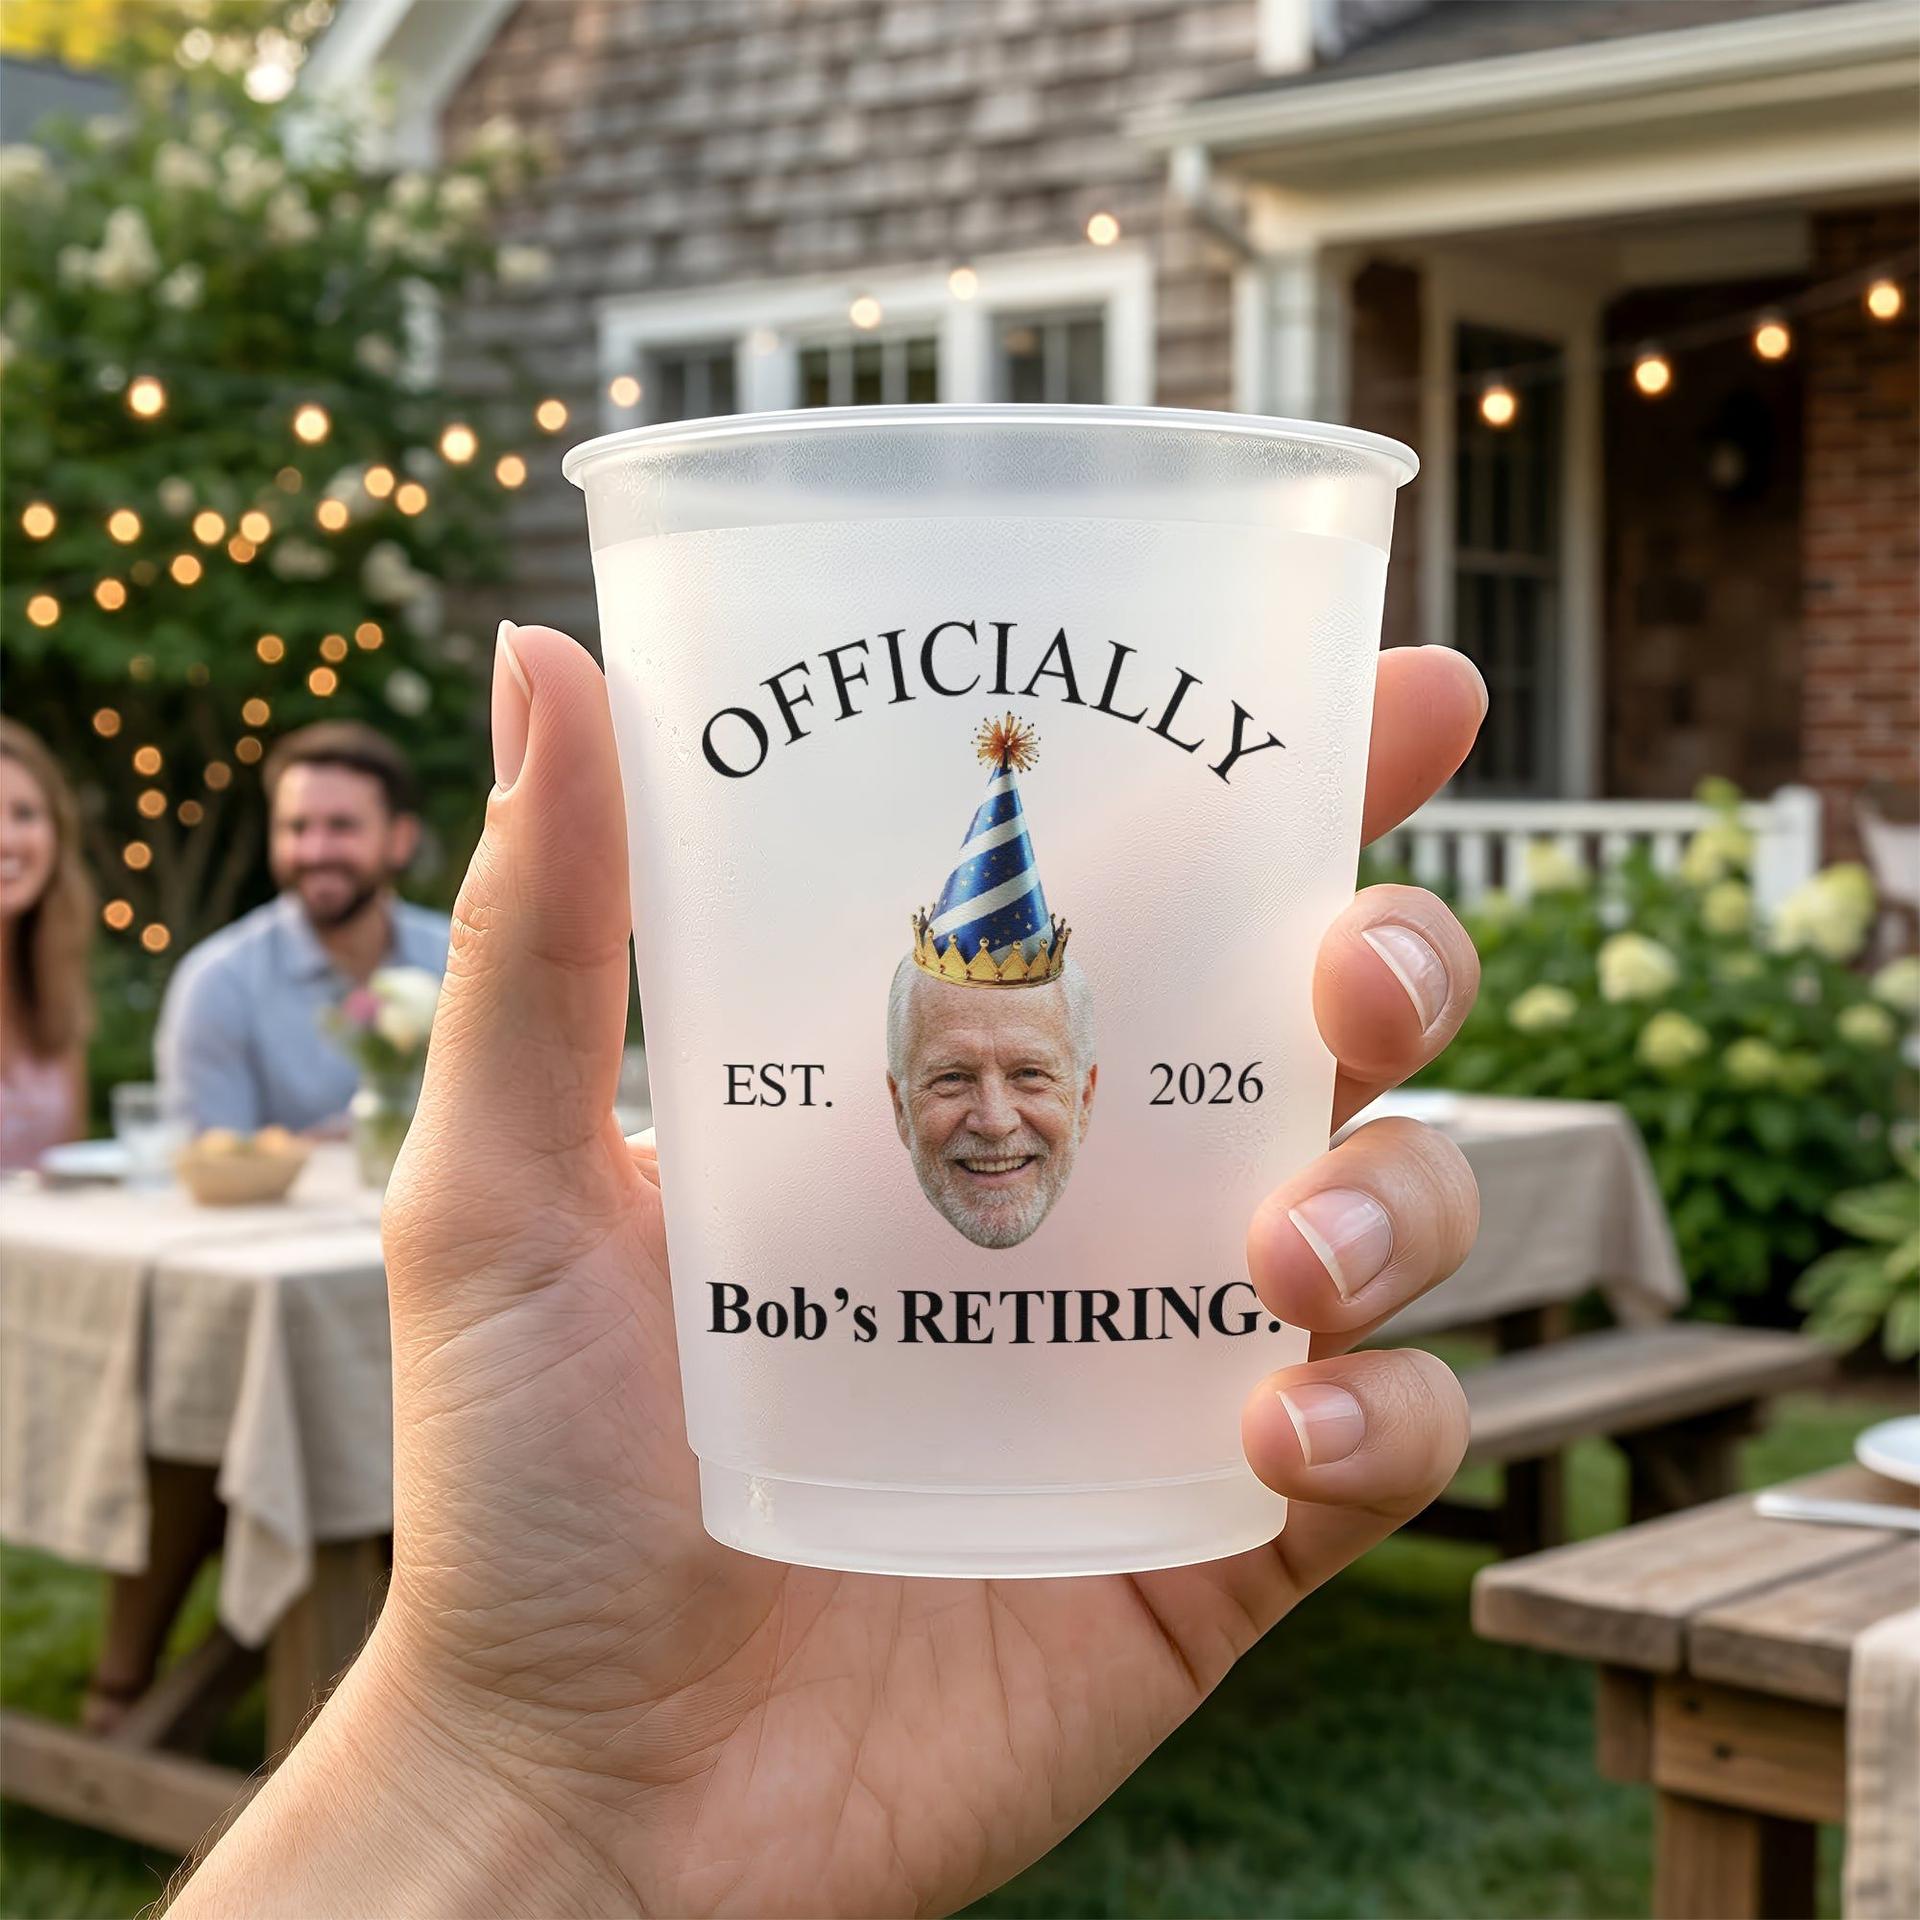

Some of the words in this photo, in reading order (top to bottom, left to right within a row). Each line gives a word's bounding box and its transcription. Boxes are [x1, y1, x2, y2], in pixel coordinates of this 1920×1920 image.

[701, 619, 1286, 785] OFFICIALLY
[723, 1063, 833, 1107] EST.
[1148, 1061, 1265, 1105] 2026
[705, 1281, 878, 1343] Bob’s
[896, 1281, 1281, 1344] RETIRING.
